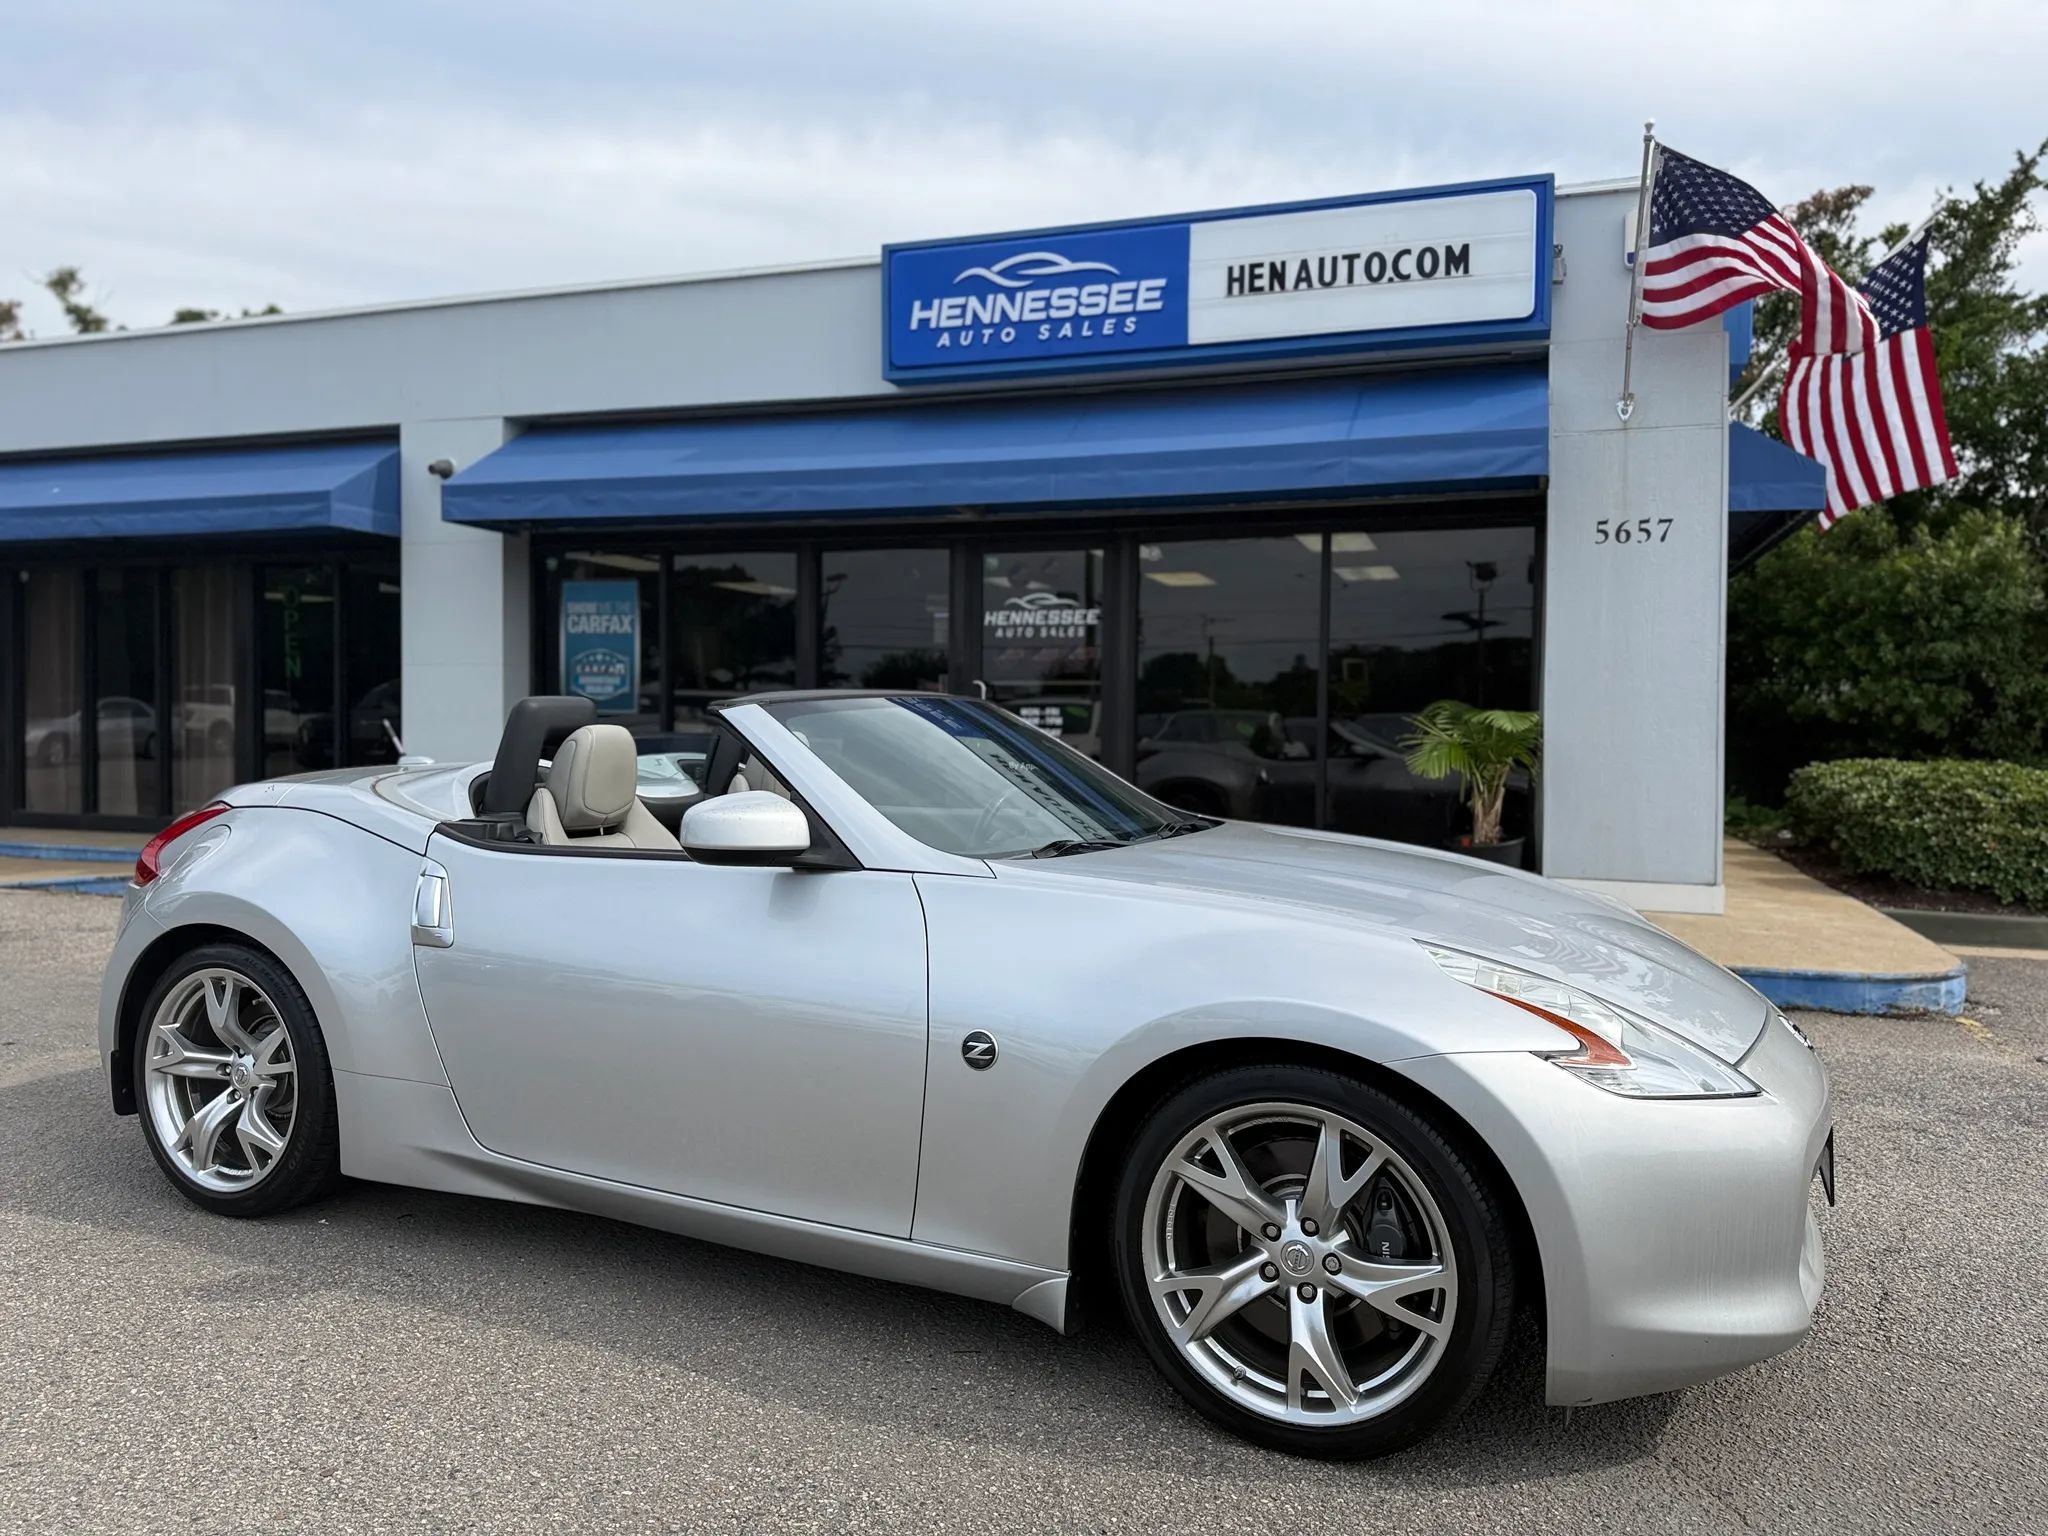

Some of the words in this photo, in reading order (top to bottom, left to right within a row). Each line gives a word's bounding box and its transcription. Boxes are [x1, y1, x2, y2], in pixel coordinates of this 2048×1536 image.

[1227, 243, 1470, 296] HENAUTO.COM
[909, 278, 1168, 330] HENNESSEE
[936, 327, 1016, 348] AUTO
[1038, 317, 1138, 341] SALES
[1594, 517, 1674, 545] 5657
[567, 614, 633, 634] CARFAX
[983, 608, 1101, 626] HENNESSEE
[995, 627, 1035, 638] AUTO
[1040, 626, 1086, 638] SALES
